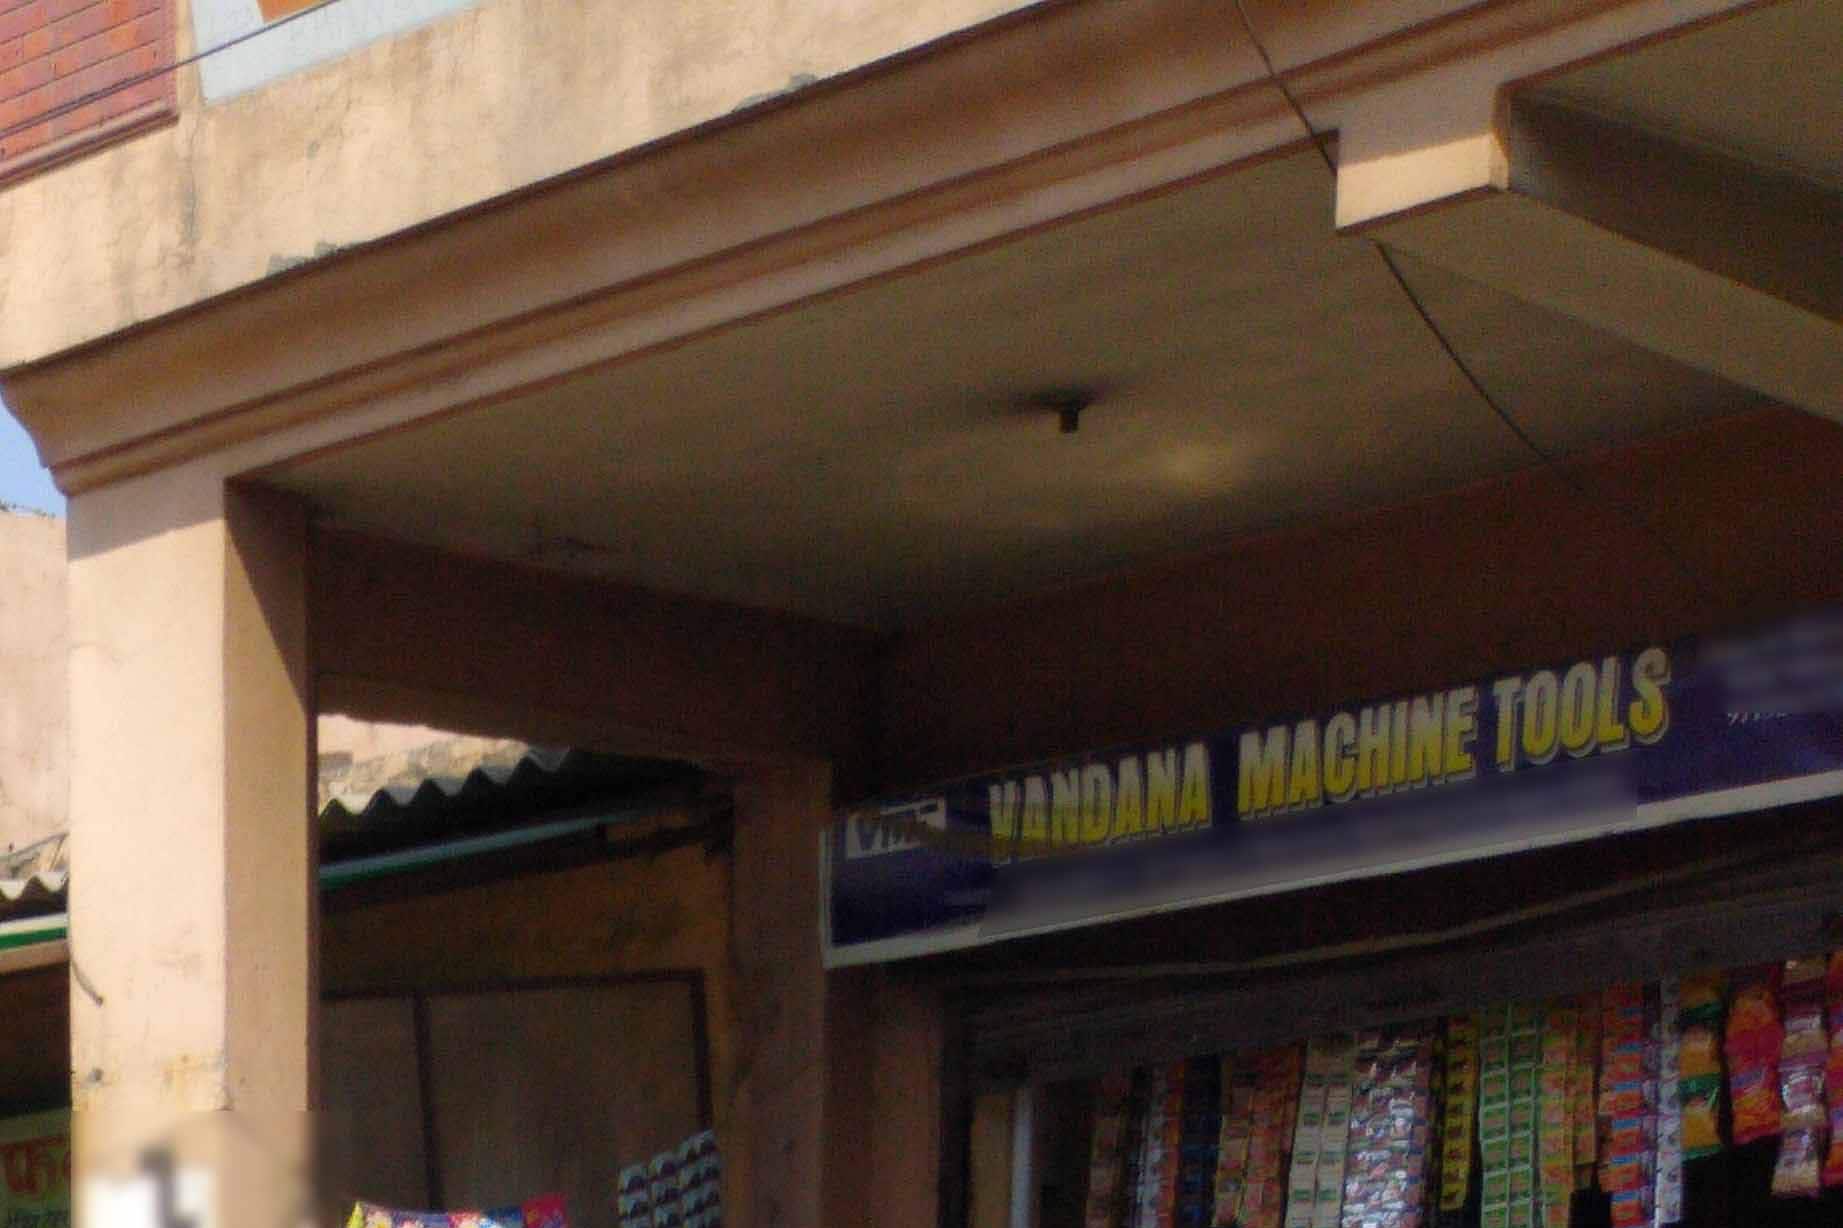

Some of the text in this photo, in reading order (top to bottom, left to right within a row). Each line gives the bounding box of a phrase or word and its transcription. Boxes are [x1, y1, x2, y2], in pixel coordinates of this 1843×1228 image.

[988, 740, 1214, 867] VANDANA
[1237, 684, 1479, 820] MACHINE
[1492, 647, 1672, 773] TOOLS
